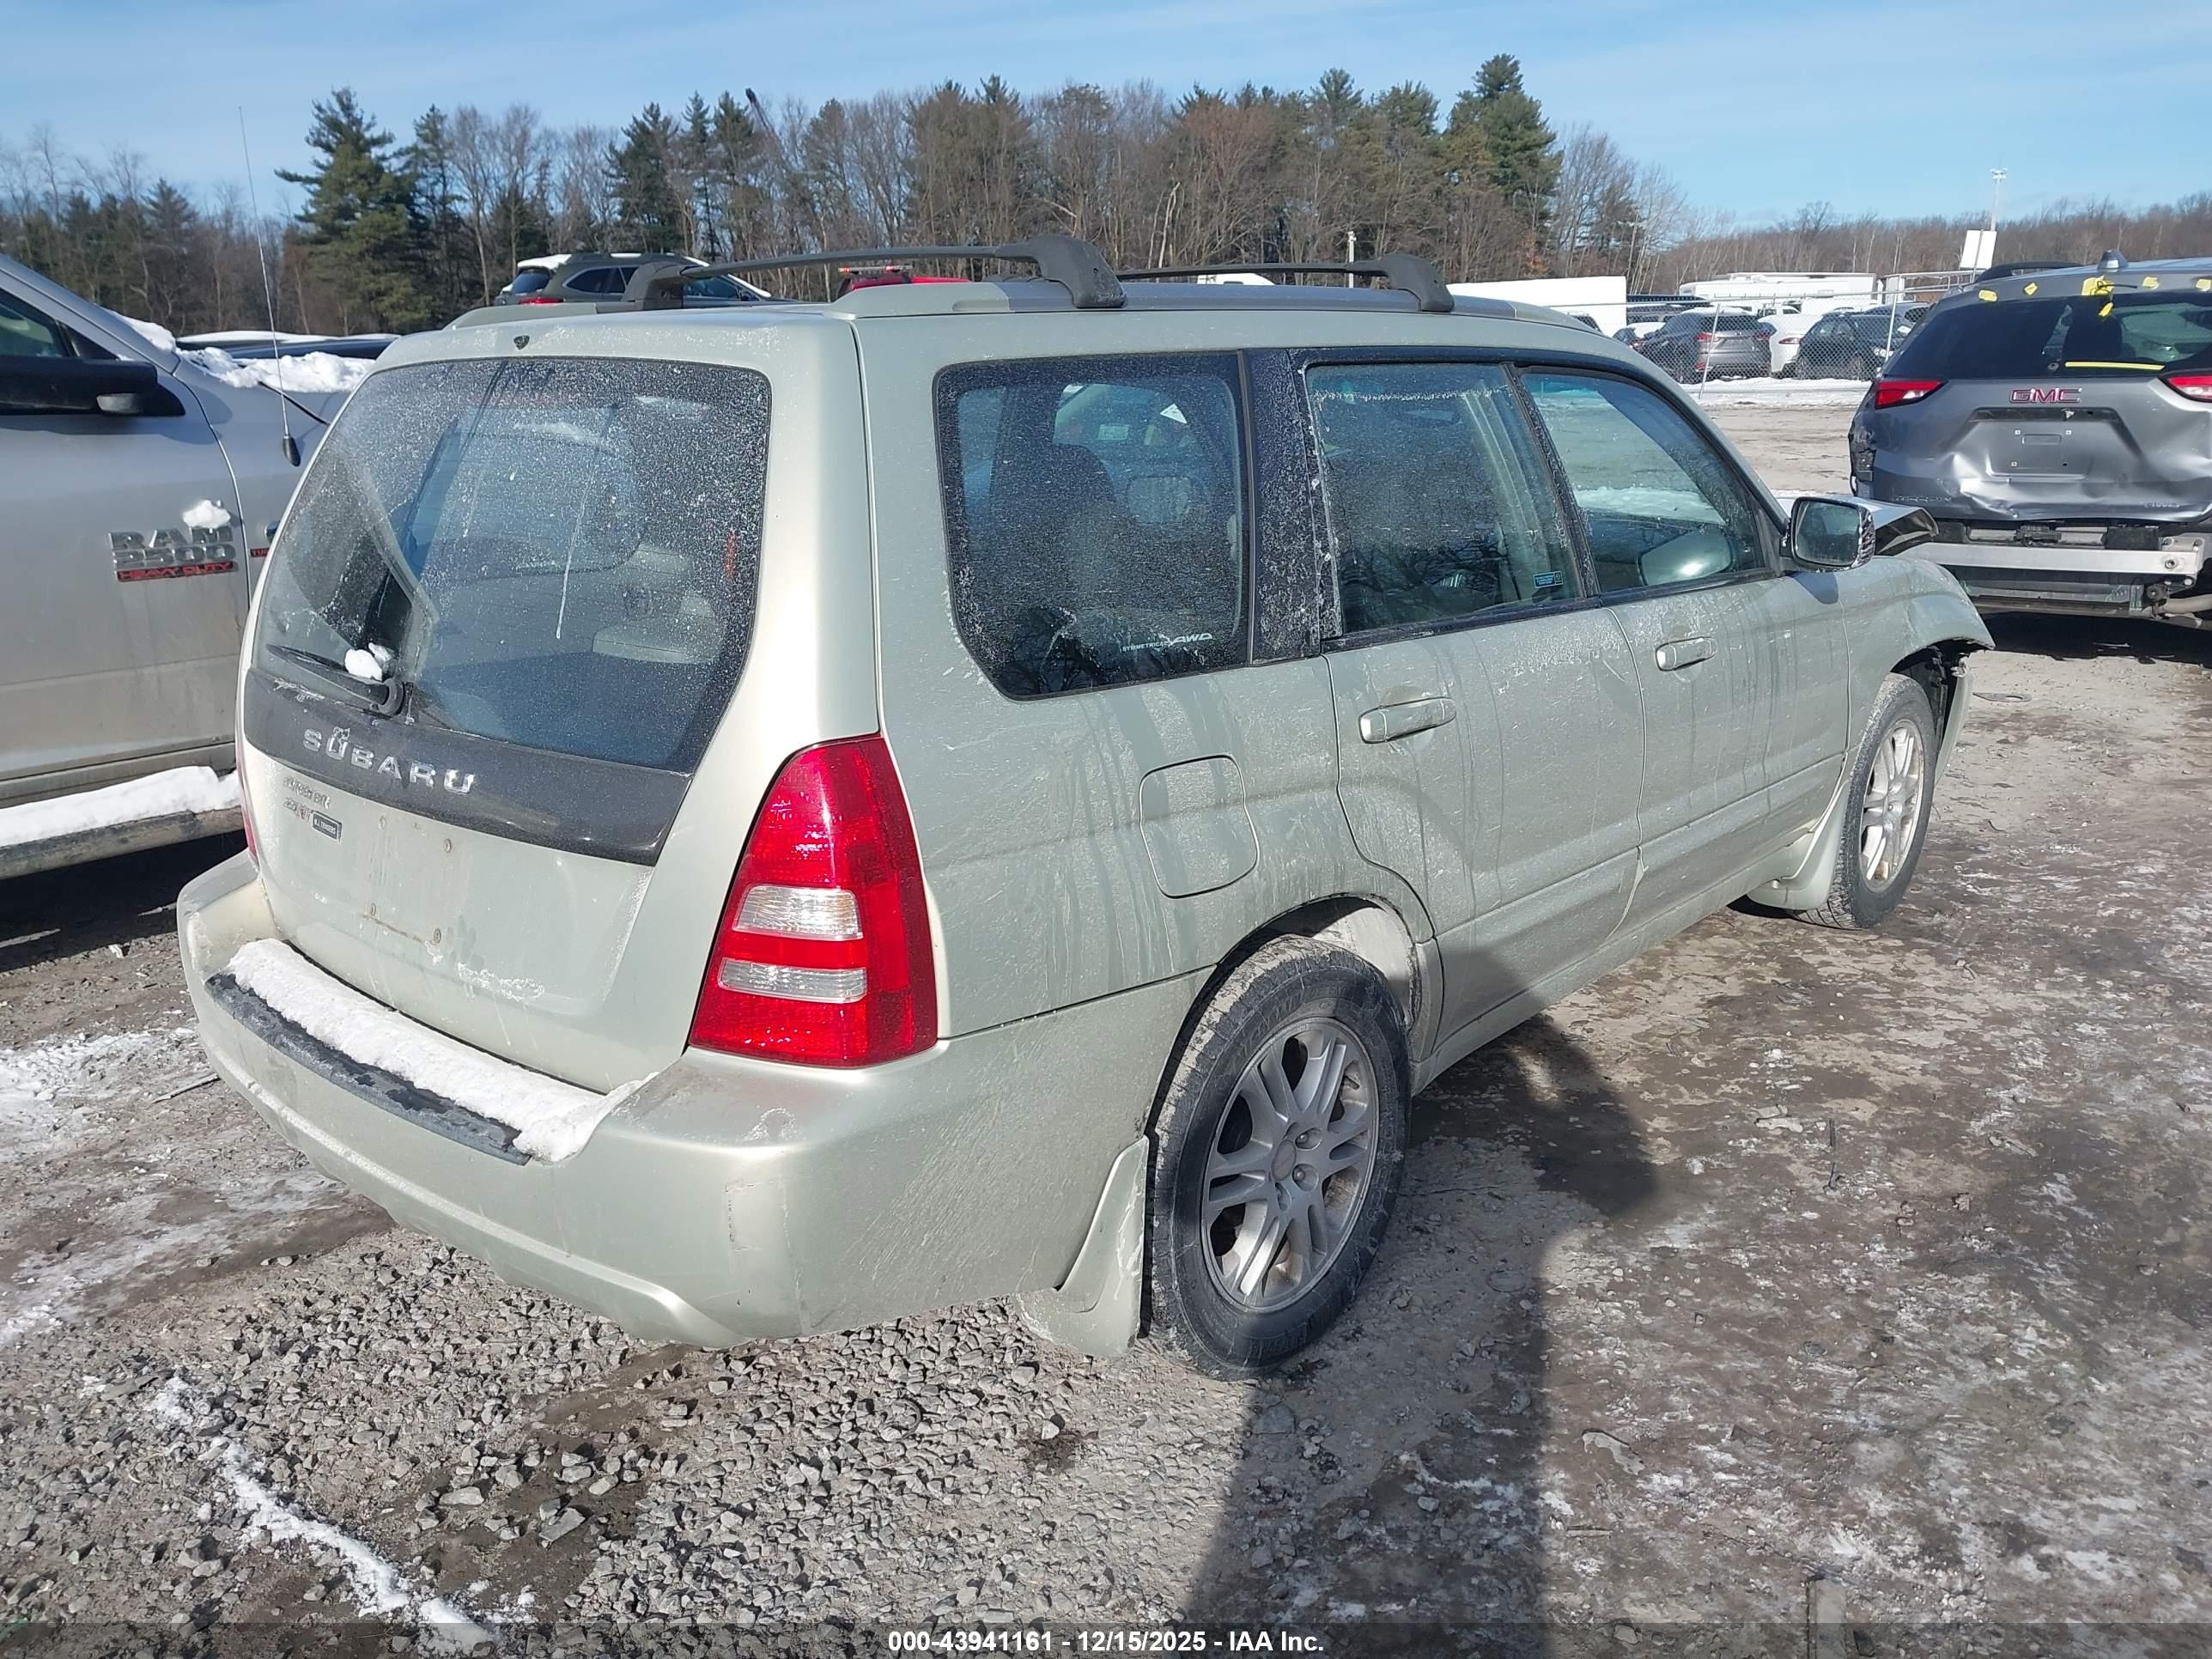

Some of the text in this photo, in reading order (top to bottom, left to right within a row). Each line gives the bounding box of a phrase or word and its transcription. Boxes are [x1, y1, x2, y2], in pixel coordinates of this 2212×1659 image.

[2009, 387, 2082, 404] GMC
[108, 526, 234, 550] RAM
[112, 544, 237, 569] 2500
[118, 562, 232, 580] HEAVY DUTY
[1171, 632, 1213, 645] AWD
[302, 727, 476, 795] SUBARU
